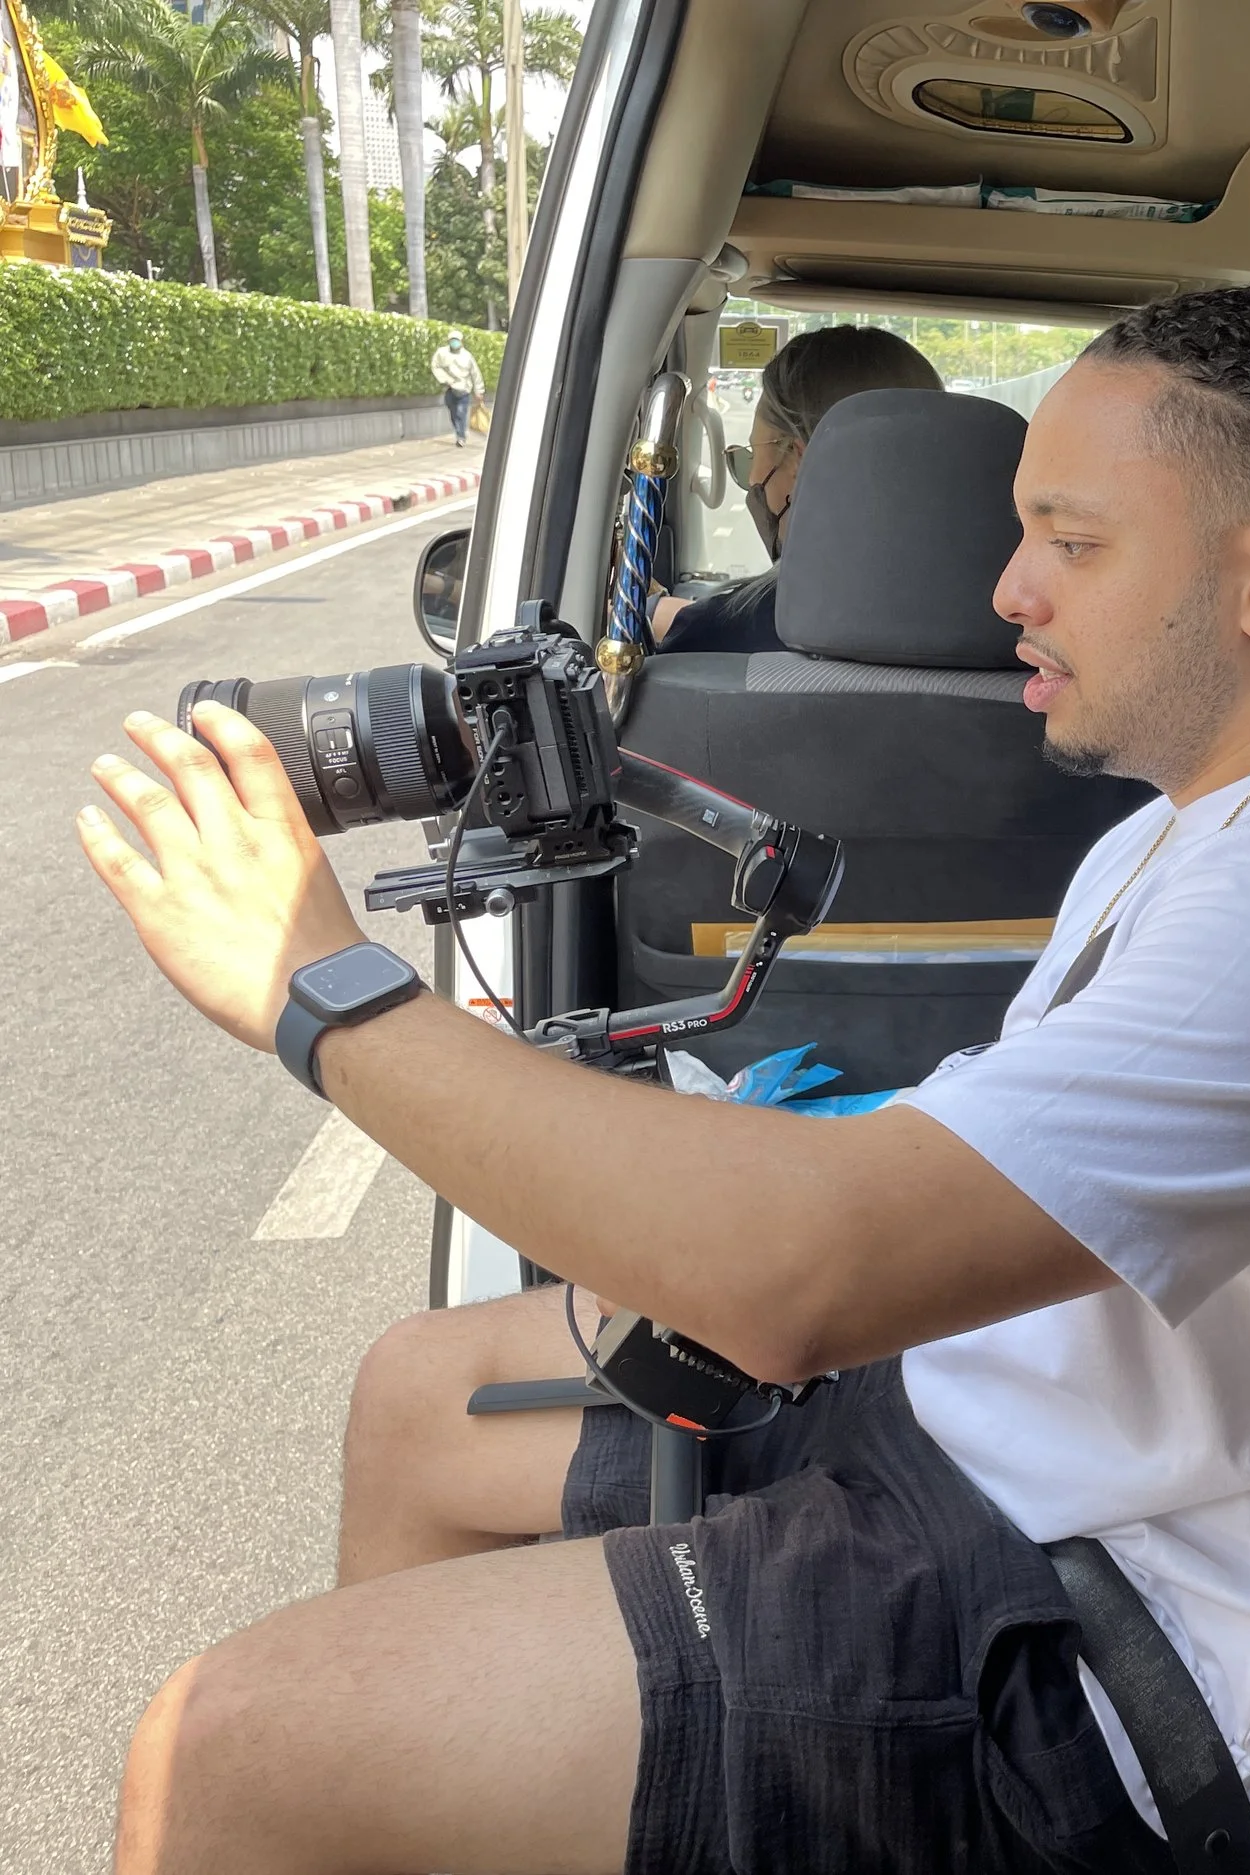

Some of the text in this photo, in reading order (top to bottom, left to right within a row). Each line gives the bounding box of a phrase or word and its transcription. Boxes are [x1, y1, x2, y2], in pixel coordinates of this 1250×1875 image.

[328, 756, 348, 764] FOCUS
[662, 1019, 708, 1034] RS3 PRO
[669, 1543, 697, 1588] Urban
